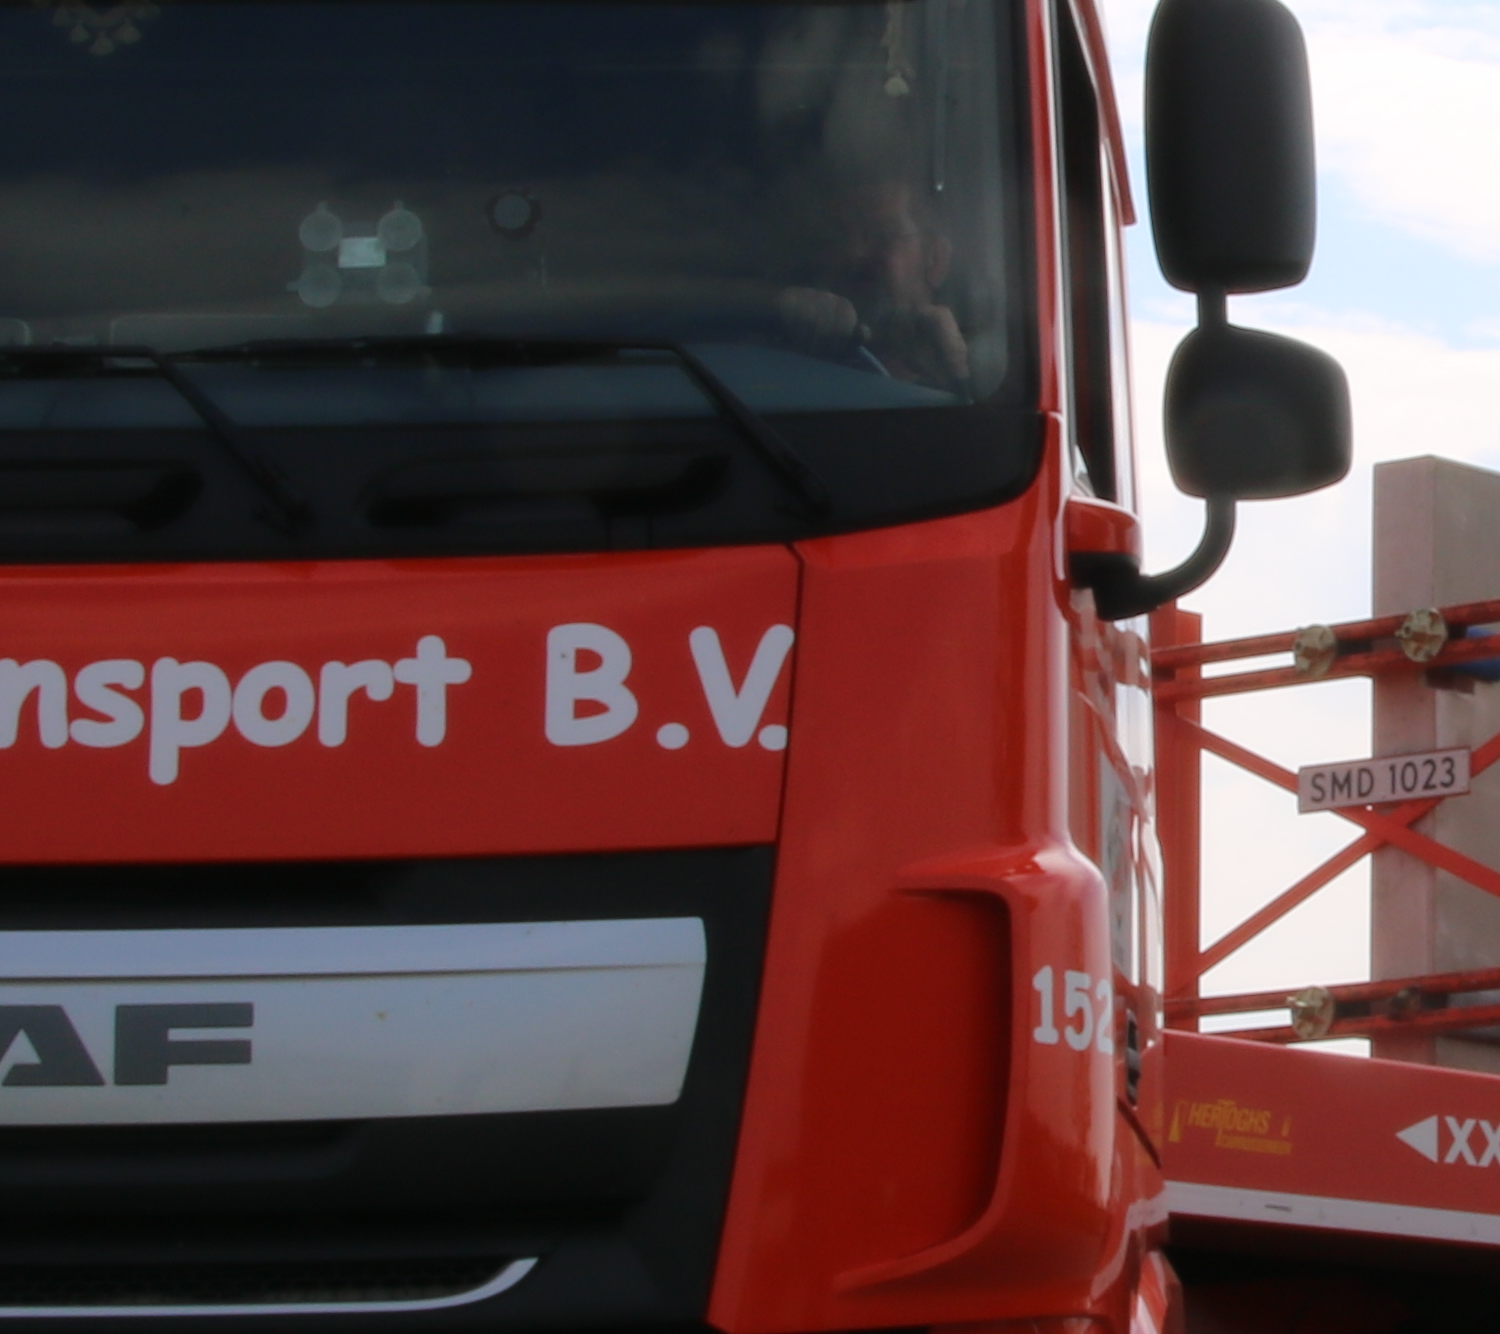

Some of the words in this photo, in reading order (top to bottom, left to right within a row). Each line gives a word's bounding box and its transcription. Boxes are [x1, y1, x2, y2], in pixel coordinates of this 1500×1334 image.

[544, 622, 796, 751] B.V.
[1310, 768, 1374, 803] SMD
[1388, 757, 1455, 795] 1023
[1032, 964, 1115, 1055] 152
